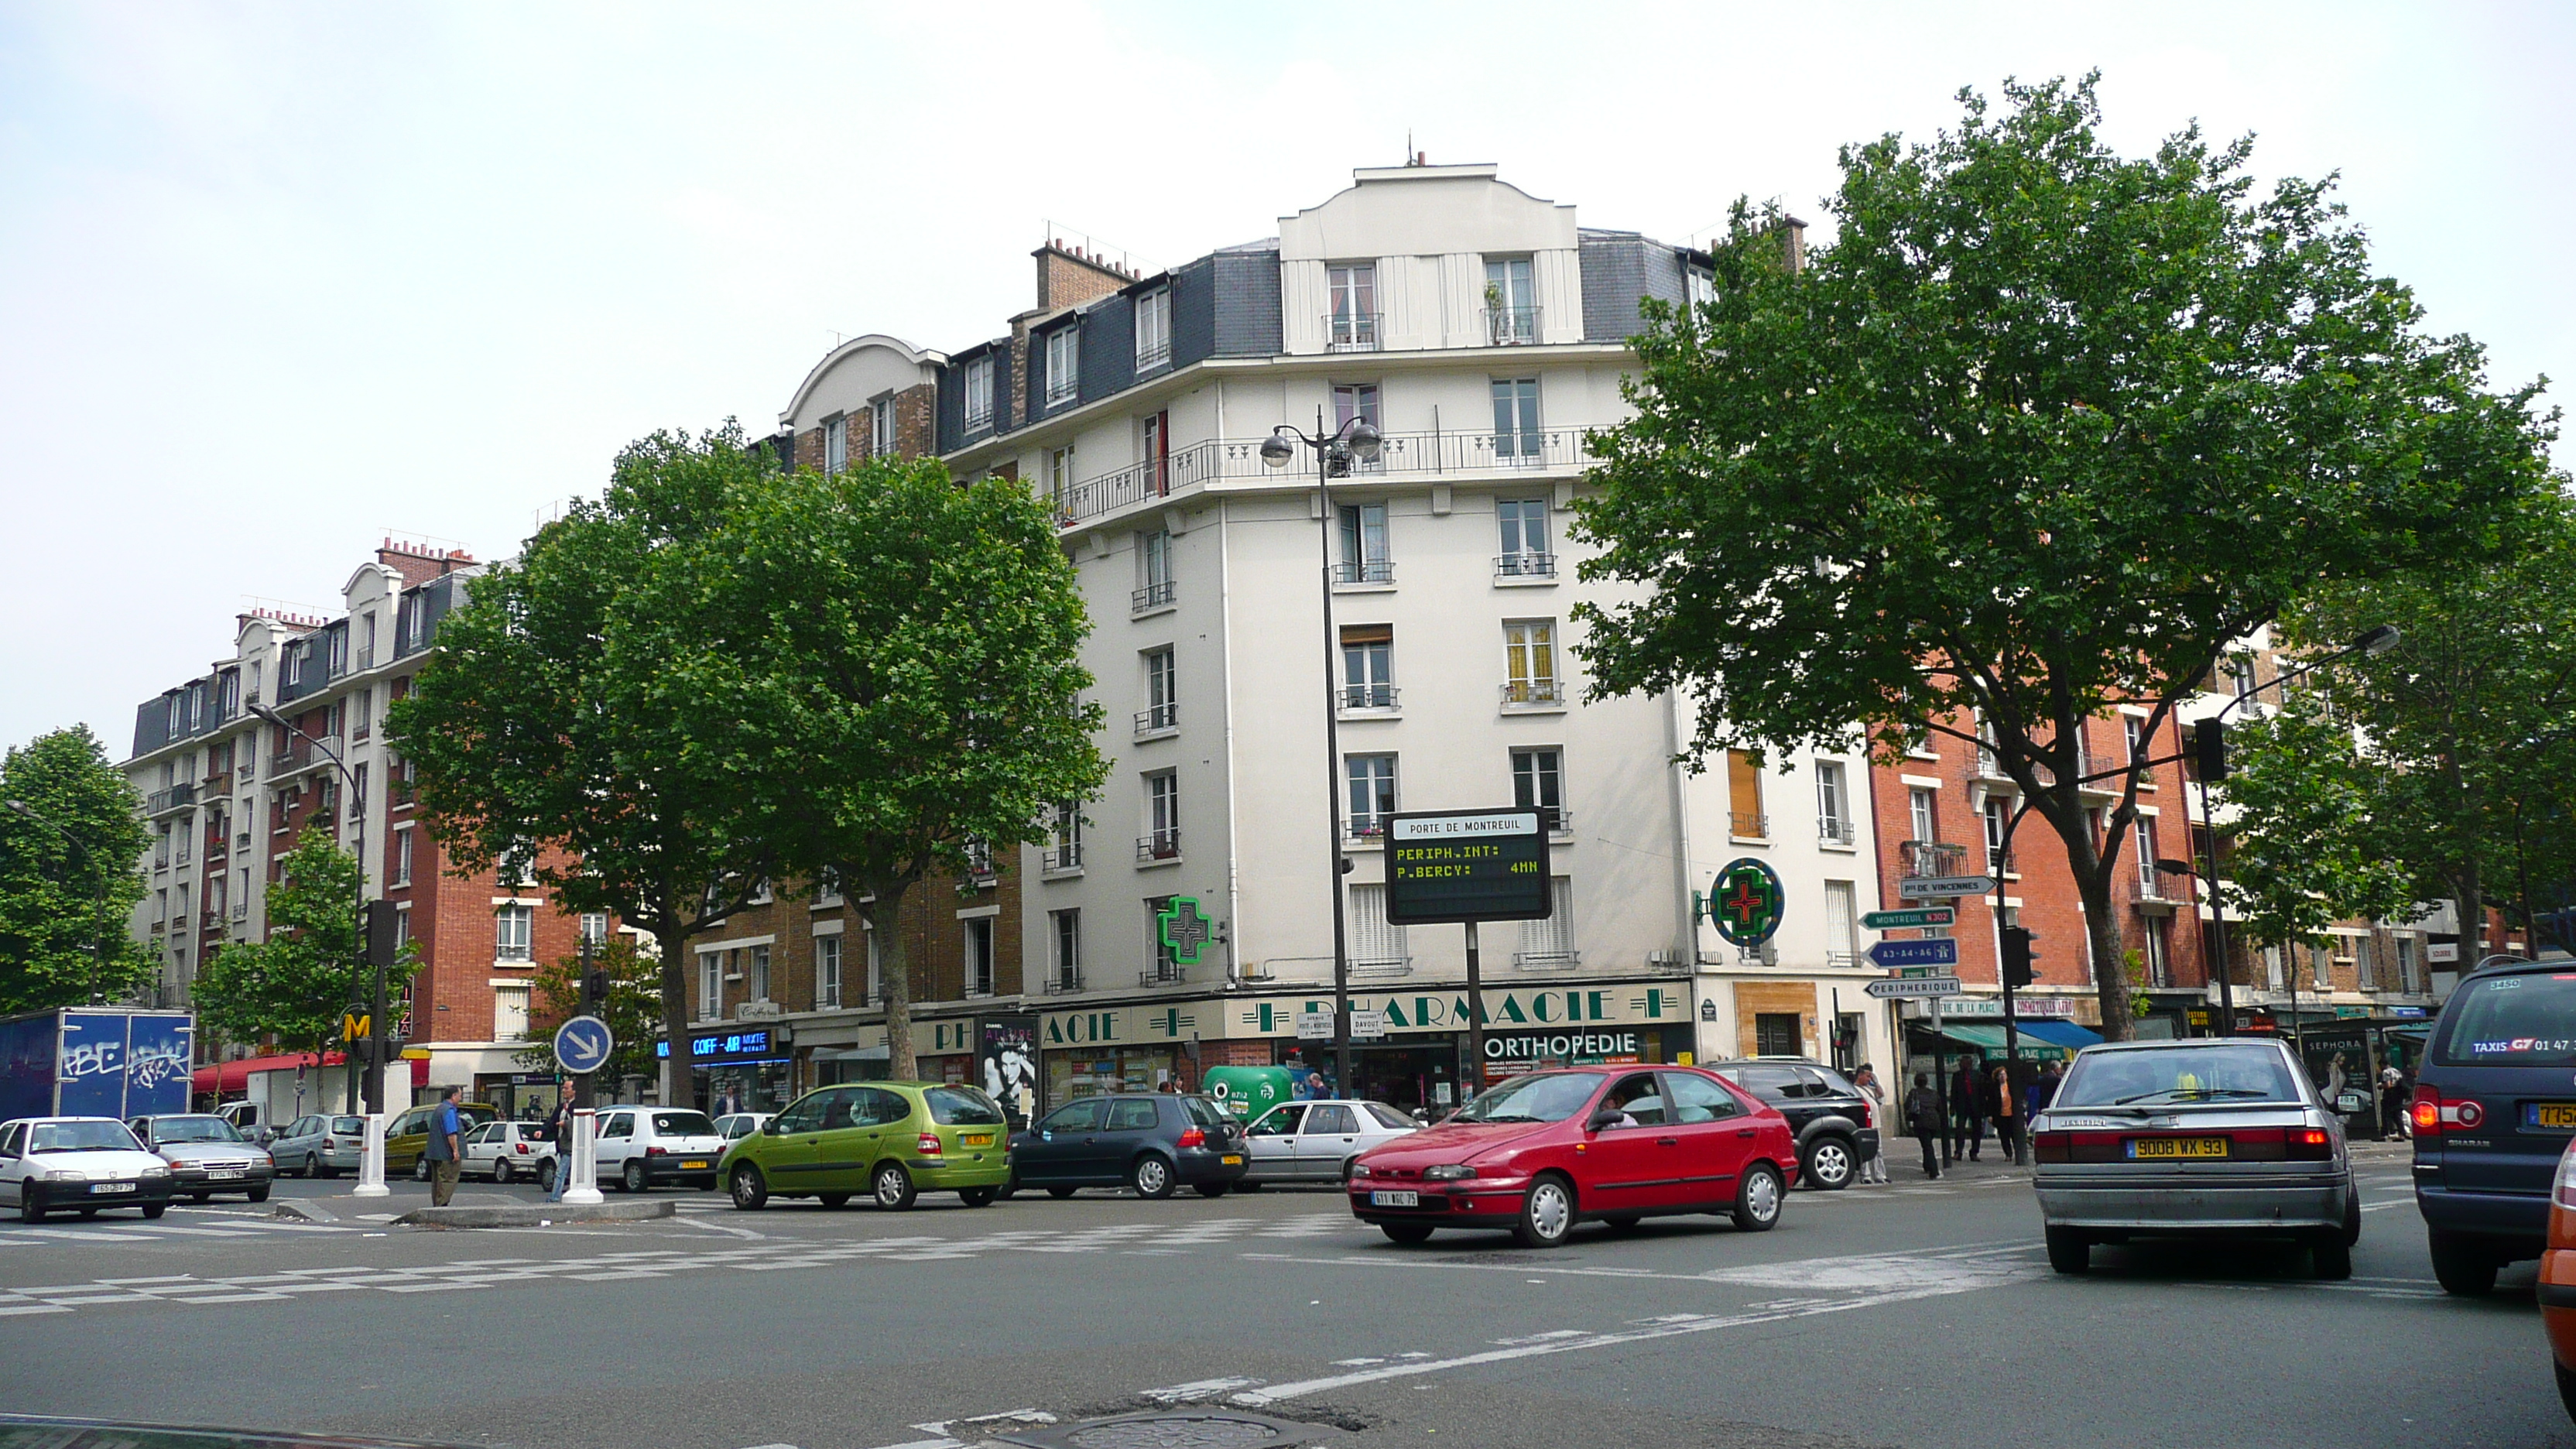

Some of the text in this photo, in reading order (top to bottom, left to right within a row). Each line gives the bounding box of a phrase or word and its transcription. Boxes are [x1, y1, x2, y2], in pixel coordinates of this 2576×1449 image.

[1410, 820, 1520, 834] PORTE DE MONTREUIL
[1396, 845, 1499, 861] PERIPH.INT:
[1397, 861, 1537, 879] P.BERCY: 4MN
[1932, 882, 1979, 891] VINCENNES
[1876, 914, 1923, 924] MONTREUIL
[1874, 983, 1955, 993] PERIPHERIQUE
[2491, 980, 2519, 989] 3450
[1957, 1003, 1964, 1012] DE
[1968, 1003, 1975, 1012] LA
[1978, 1003, 1995, 1012] PLACE
[344, 1014, 370, 1042] M
[742, 1033, 766, 1044] MIXTE
[2309, 1040, 2361, 1050] SEPHORA
[1485, 1033, 1636, 1058] ORTHOPEDIE
[2474, 1043, 2508, 1052] TAXIS
[2511, 1039, 2533, 1050] G7
[2535, 1040, 2549, 1051] 01
[2554, 1040, 2569, 1051] 47
[2540, 1106, 2576, 1123] 775
[2139, 1140, 2174, 1156] 9008
[2180, 1140, 2197, 1155] WX
[2203, 1139, 2221, 1154] 93
